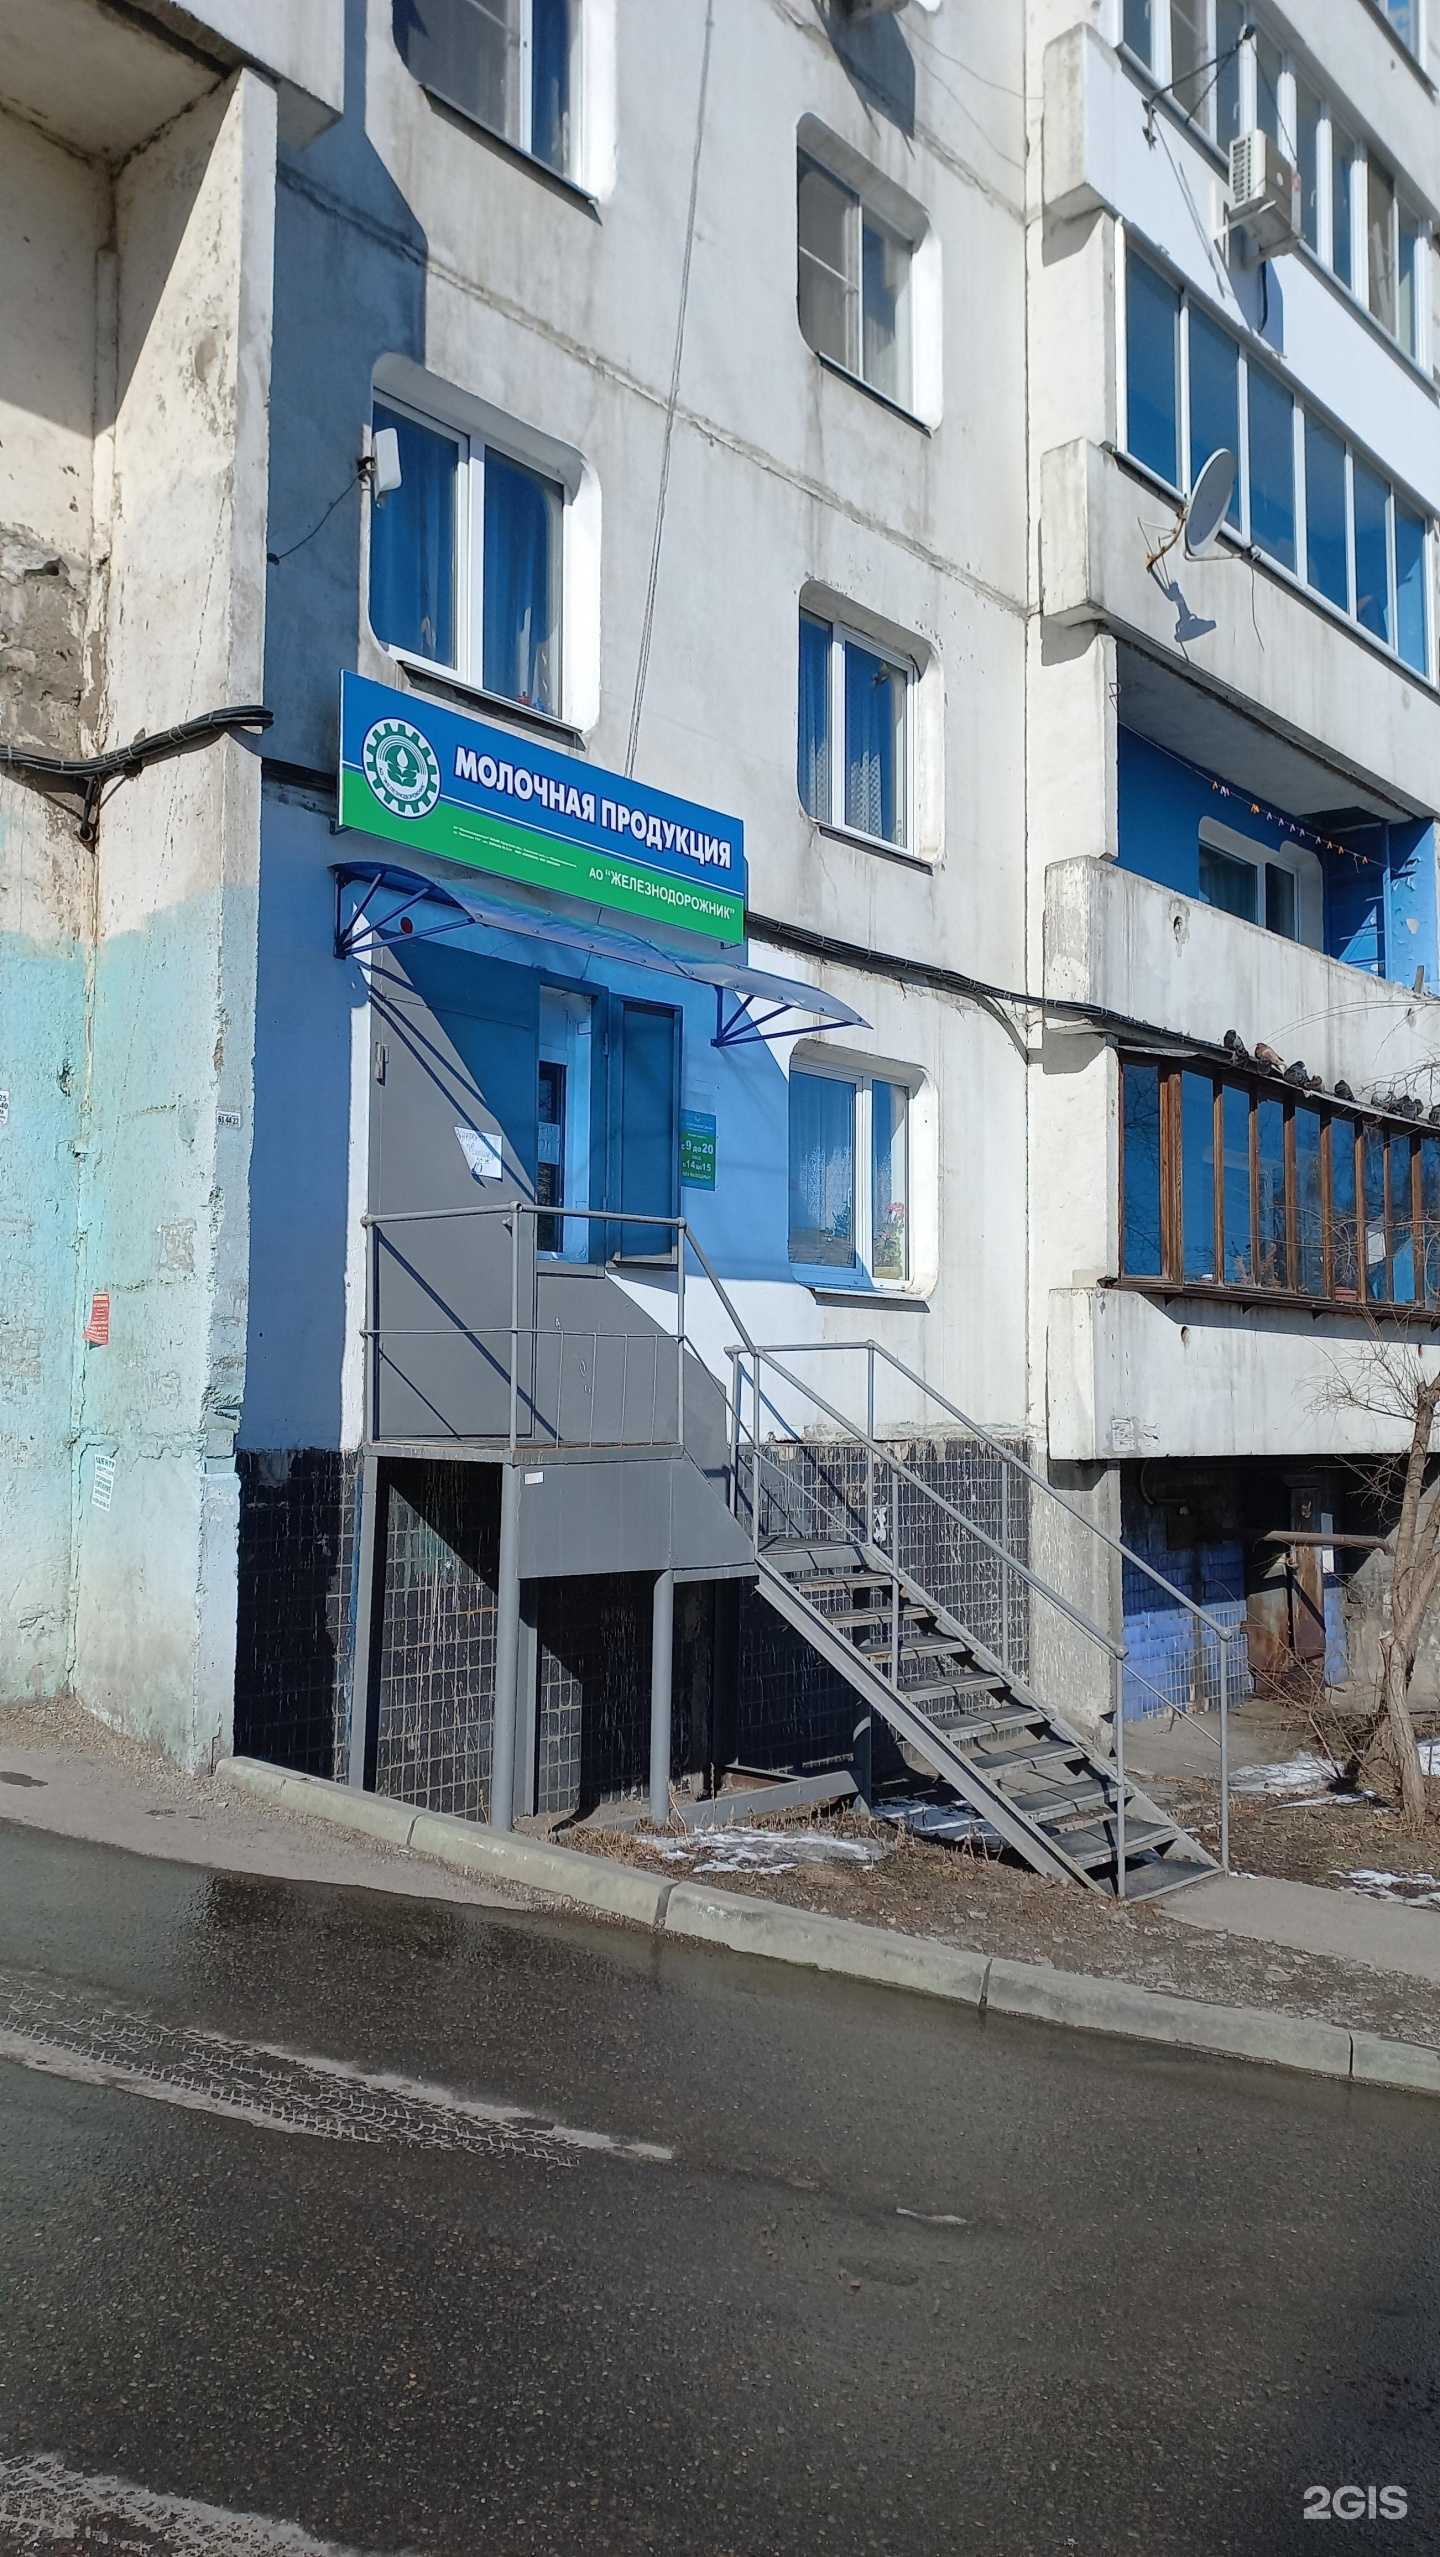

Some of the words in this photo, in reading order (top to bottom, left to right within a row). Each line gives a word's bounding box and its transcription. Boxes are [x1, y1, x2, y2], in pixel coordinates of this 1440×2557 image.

[454, 745, 596, 824] МОЛОЧНАЯ
[601, 798, 732, 869] ПРОДУКЦИЯ
[589, 866, 604, 882] АО
[686, 1140, 692, 1151] 9
[692, 1145, 702, 1153] до
[702, 1143, 714, 1154] 20
[687, 1160, 696, 1168] 14
[703, 1163, 711, 1171] 15
